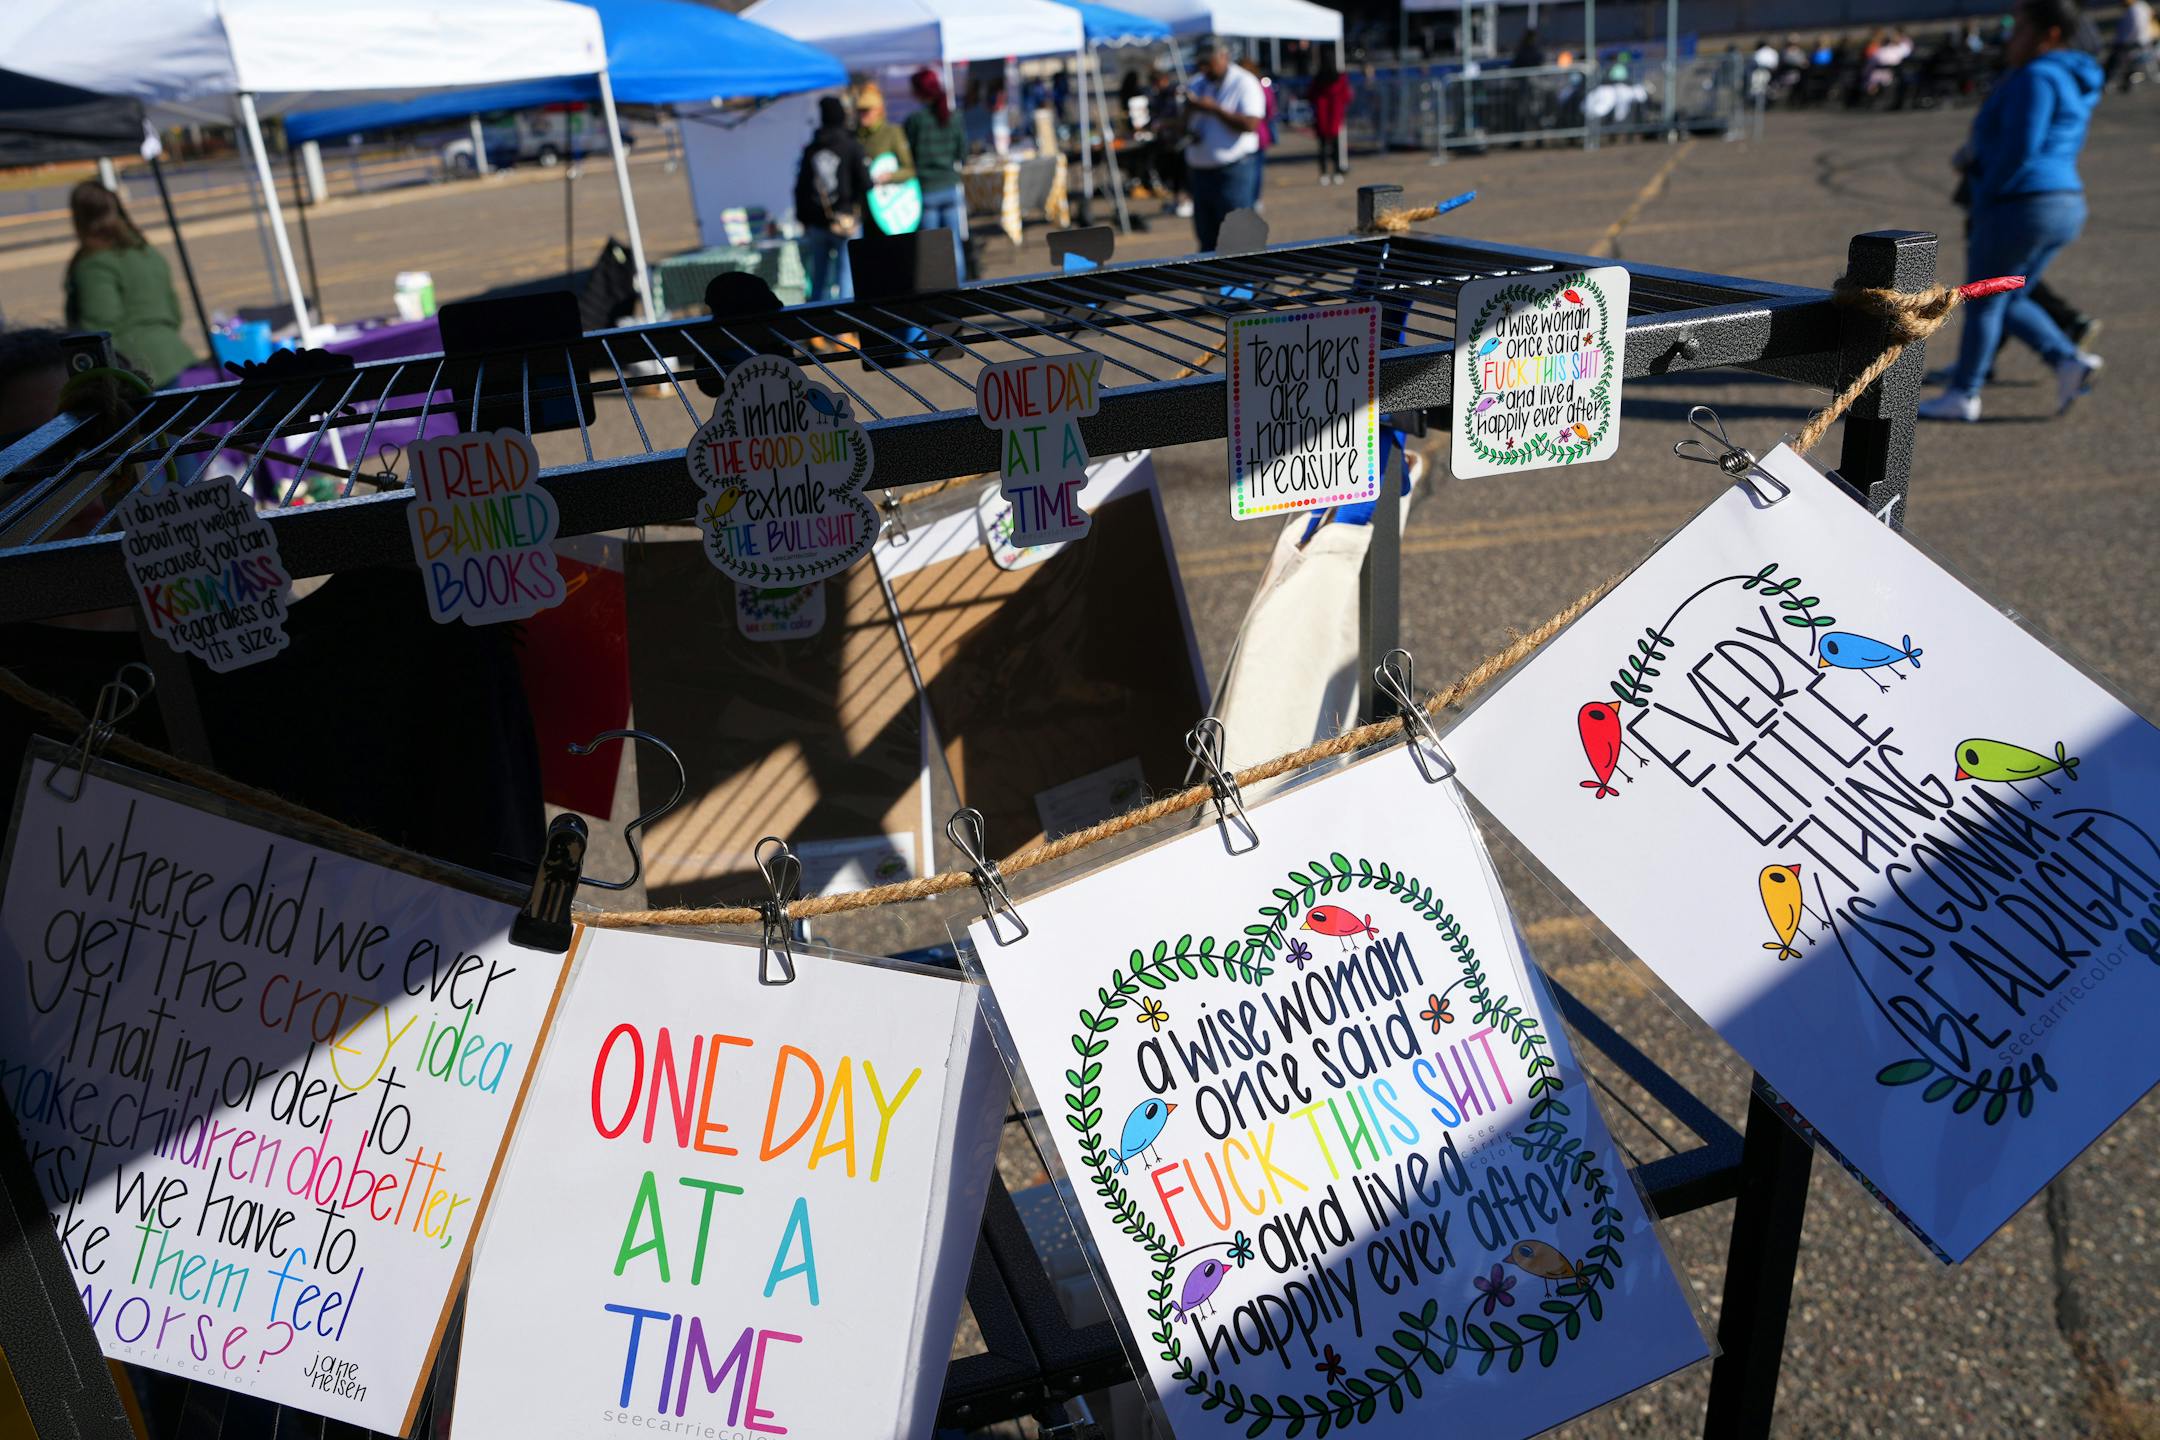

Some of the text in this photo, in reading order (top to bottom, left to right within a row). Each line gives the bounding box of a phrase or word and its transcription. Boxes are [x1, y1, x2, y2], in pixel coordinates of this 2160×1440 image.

[1496, 307, 1590, 337] a wise woman
[1506, 331, 1580, 359] once said
[1248, 324, 1360, 387] teachers
[1484, 350, 1601, 390] FUCK THIS SHIT
[742, 381, 808, 438] inhale
[984, 359, 1097, 422] ONE DAY
[1270, 378, 1338, 421] are a
[1506, 380, 1574, 409] and lived
[708, 429, 850, 475] THE GOOD SHIT
[1008, 423, 1084, 477] AT A
[1257, 398, 1356, 460] national
[1477, 405, 1529, 440] happily
[1534, 405, 1563, 428] ever
[419, 438, 529, 502] I READ
[745, 464, 824, 521] exhale
[1247, 448, 1359, 498] treasure
[124, 483, 229, 526] i do not worry
[129, 502, 250, 556] about my weight
[417, 493, 549, 560] BANNED
[724, 513, 856, 558] THE BULLSHIT
[1008, 480, 1085, 533] TIME
[133, 528, 270, 584] because you can
[431, 551, 556, 613] BOOKS
[144, 556, 283, 628] KISS MY ASS
[170, 589, 280, 650] regardless of
[208, 627, 283, 664] its size.
[1627, 606, 1824, 788] EVERY
[1702, 672, 1894, 846] LITTLE
[1779, 744, 1954, 892] THING
[58, 800, 516, 1015] where did we ever
[1837, 785, 2060, 974] IS GONNA
[1887, 817, 2160, 1072] BE ALRIGHT
[28, 900, 513, 1094] get the crazy idea
[1137, 931, 1424, 1094] a wise woman
[1999, 945, 2128, 1065] seecarriecolor
[73, 977, 411, 1155] that in order to
[1195, 998, 1422, 1140] once said
[591, 1023, 922, 1182] ONE DAY
[1467, 1124, 1495, 1143] see
[106, 1069, 281, 1189] children
[286, 1119, 343, 1210] do
[342, 1130, 472, 1250] better,
[1150, 1026, 1513, 1247] FUCK THIS SHIT
[1461, 1130, 1512, 1158] carrie
[1470, 1143, 1515, 1169] color
[114, 1162, 188, 1229] we
[197, 1156, 295, 1260] have
[314, 1199, 357, 1275] to
[1258, 1131, 1471, 1275] and lived
[613, 1170, 820, 1306] AT A
[1191, 1157, 1592, 1376] happily ever after.
[131, 1208, 249, 1312] them
[268, 1246, 364, 1342] feel
[304, 1350, 359, 1381] jane
[311, 1370, 367, 1402] nelsen
[604, 1303, 803, 1435] TIME
